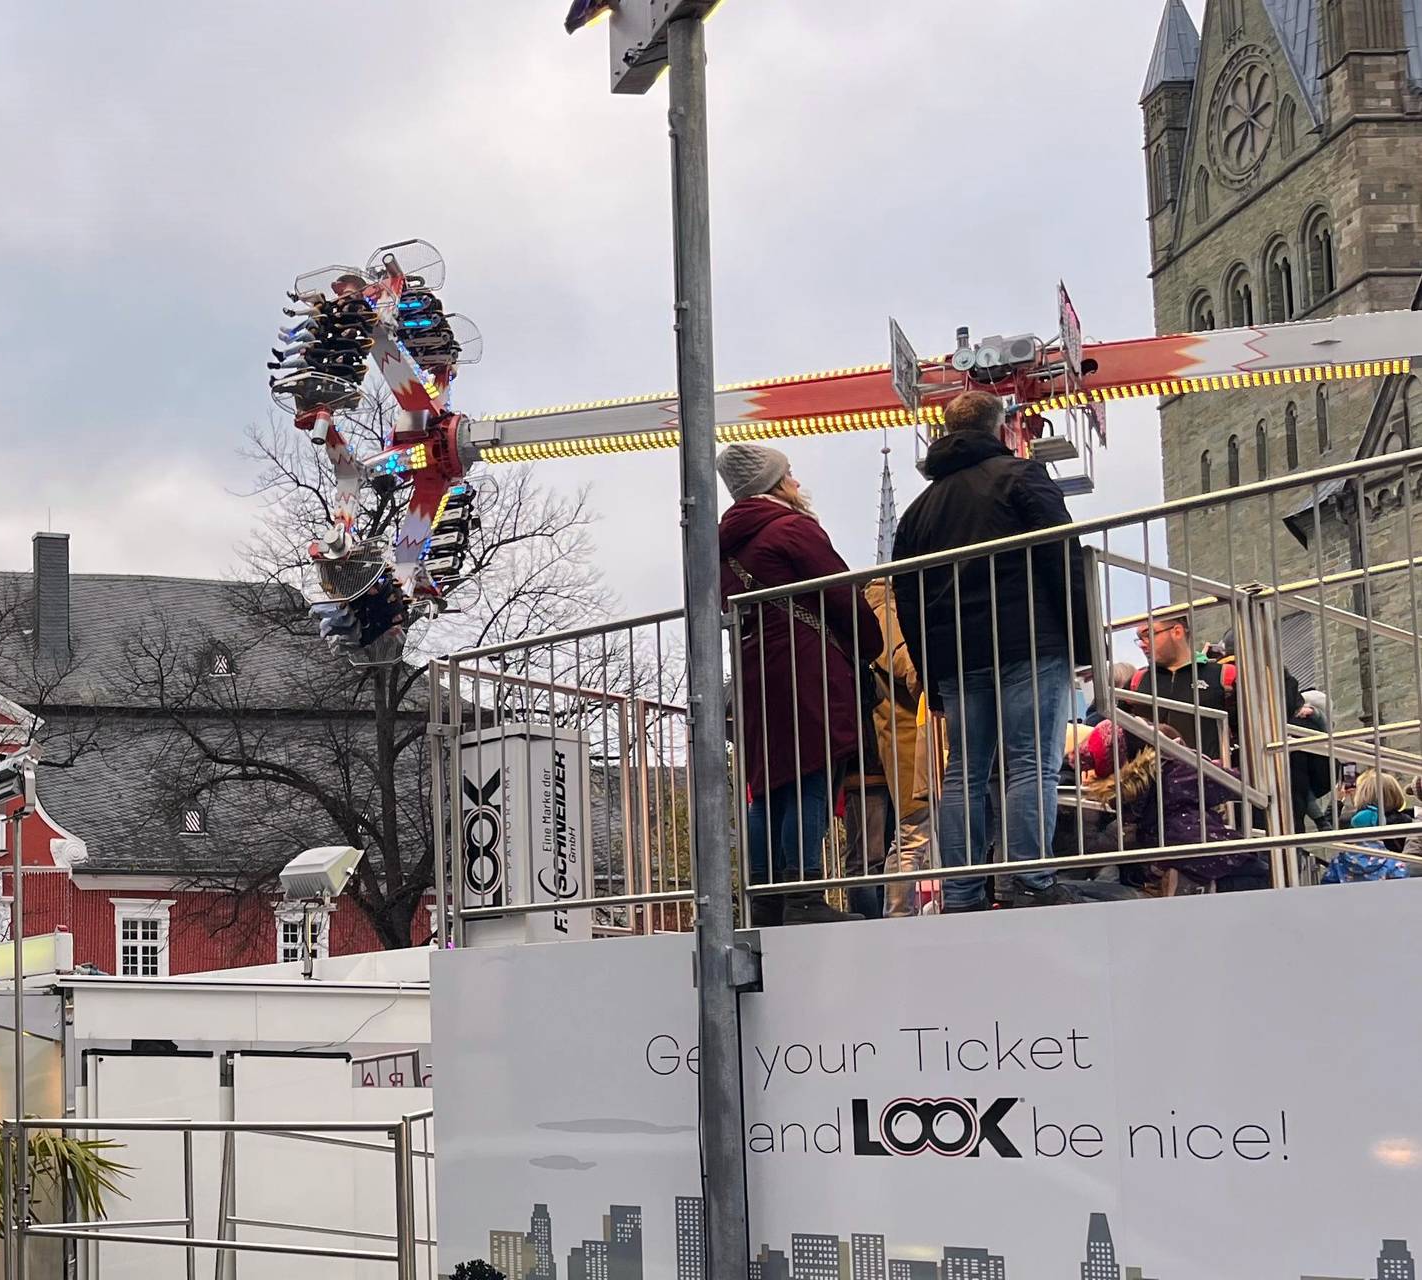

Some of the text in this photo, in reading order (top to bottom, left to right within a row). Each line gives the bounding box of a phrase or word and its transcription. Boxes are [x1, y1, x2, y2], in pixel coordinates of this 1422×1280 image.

[463, 767, 503, 921] LOOK
[542, 768, 552, 852] Eine Marke der
[553, 750, 568, 893] SCHNEIDER
[568, 826, 577, 864] GmbH
[755, 1042, 876, 1091] your
[899, 1021, 1093, 1072] Ticket
[749, 1096, 1289, 1161] and LOOK be nice!
